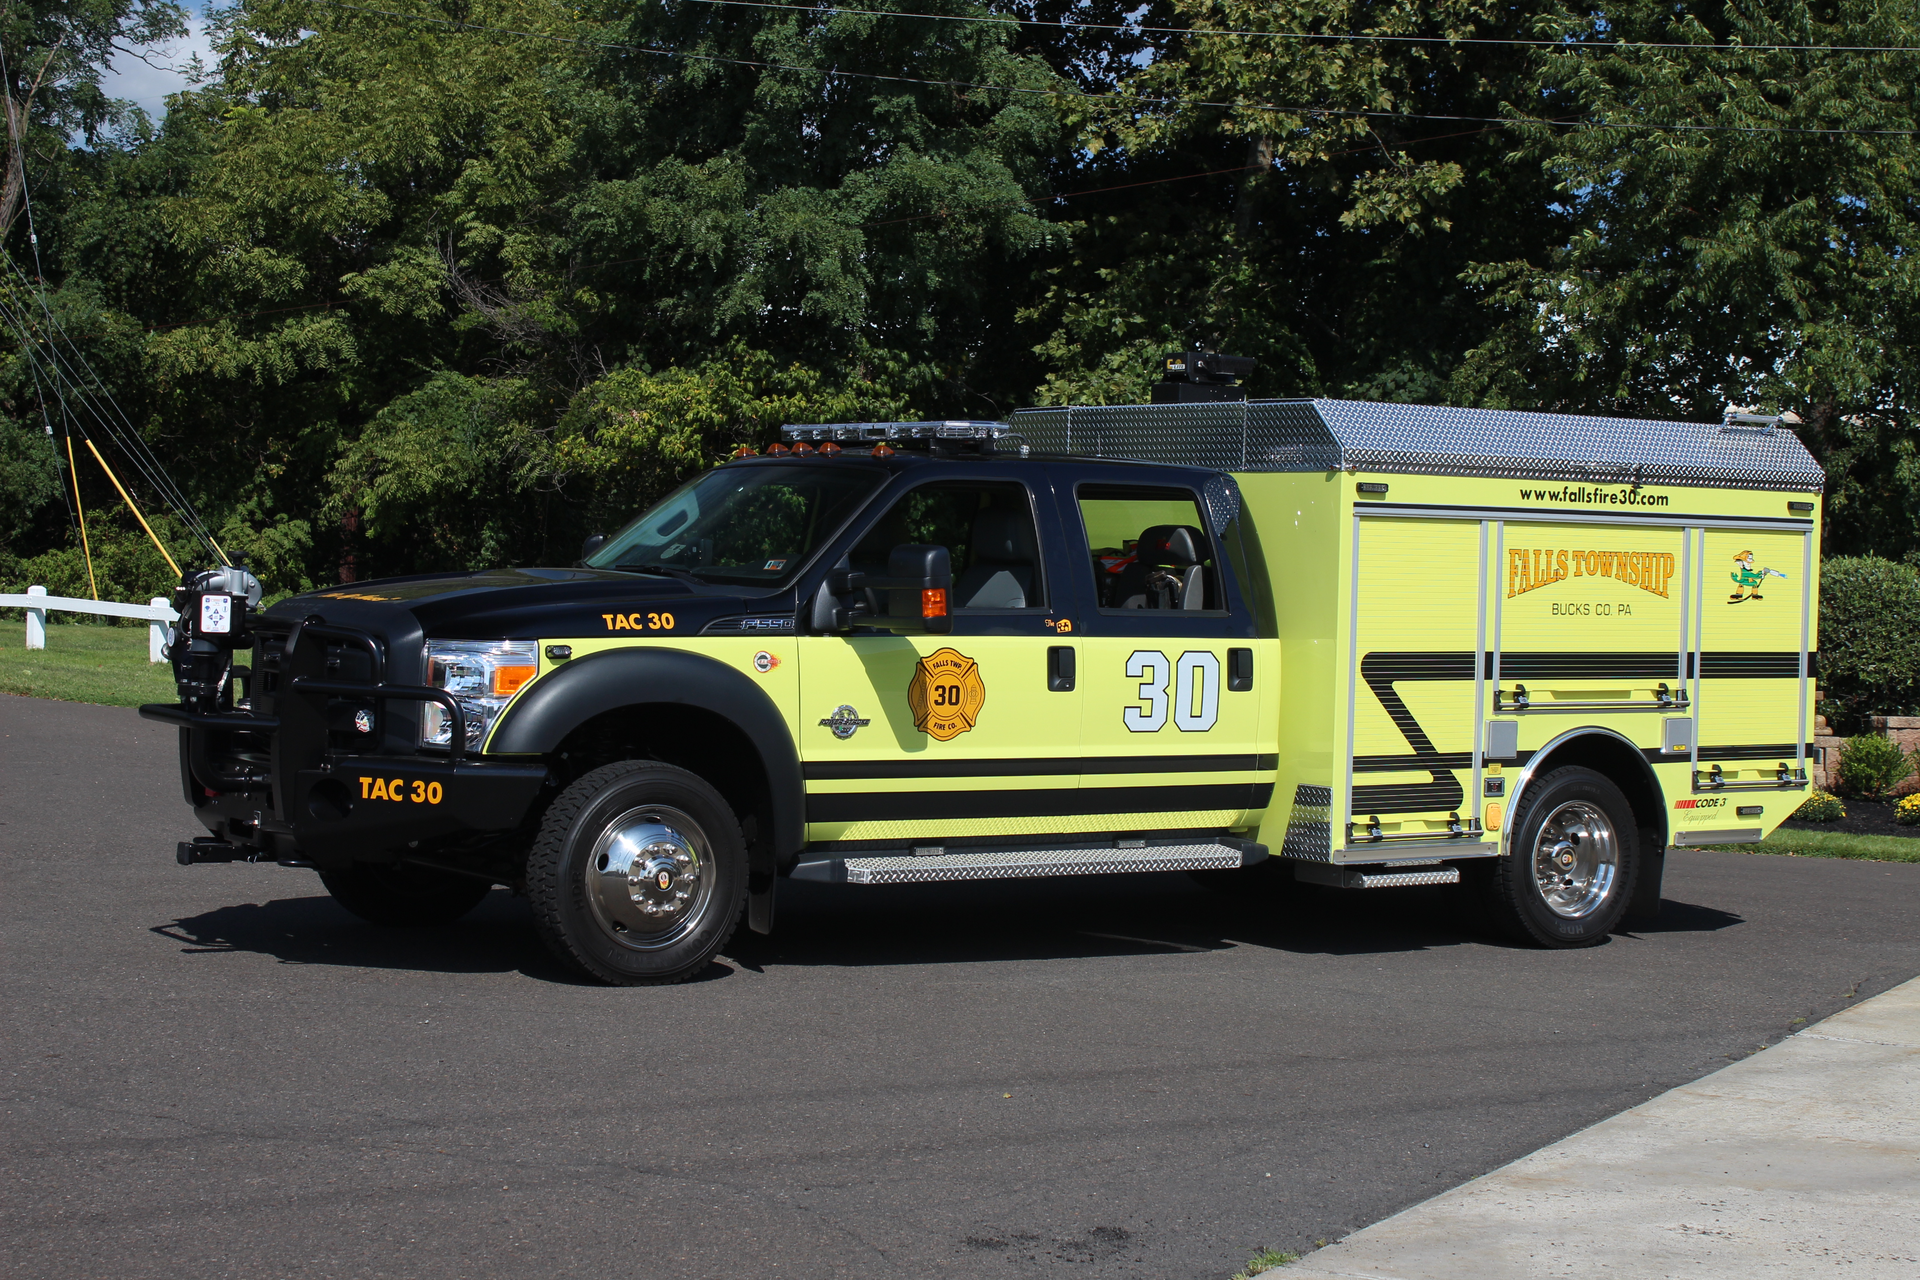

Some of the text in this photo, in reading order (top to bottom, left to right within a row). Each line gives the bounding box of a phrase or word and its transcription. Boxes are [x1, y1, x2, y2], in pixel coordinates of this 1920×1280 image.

[1520, 486, 1669, 506] www.fallsfire30.com
[1508, 548, 1675, 599] FALLS TOWNSHIP
[1551, 603, 1632, 616] BUCKS CO. PA
[602, 612, 675, 630] TAC 30
[932, 659, 949, 670] FALLS
[933, 685, 961, 706] 30
[1123, 649, 1220, 733] 30
[933, 721, 946, 731] FIRE
[359, 777, 443, 804] TAC 30
[1695, 798, 1719, 808] CODE
[1682, 809, 1720, 826] Equipped
